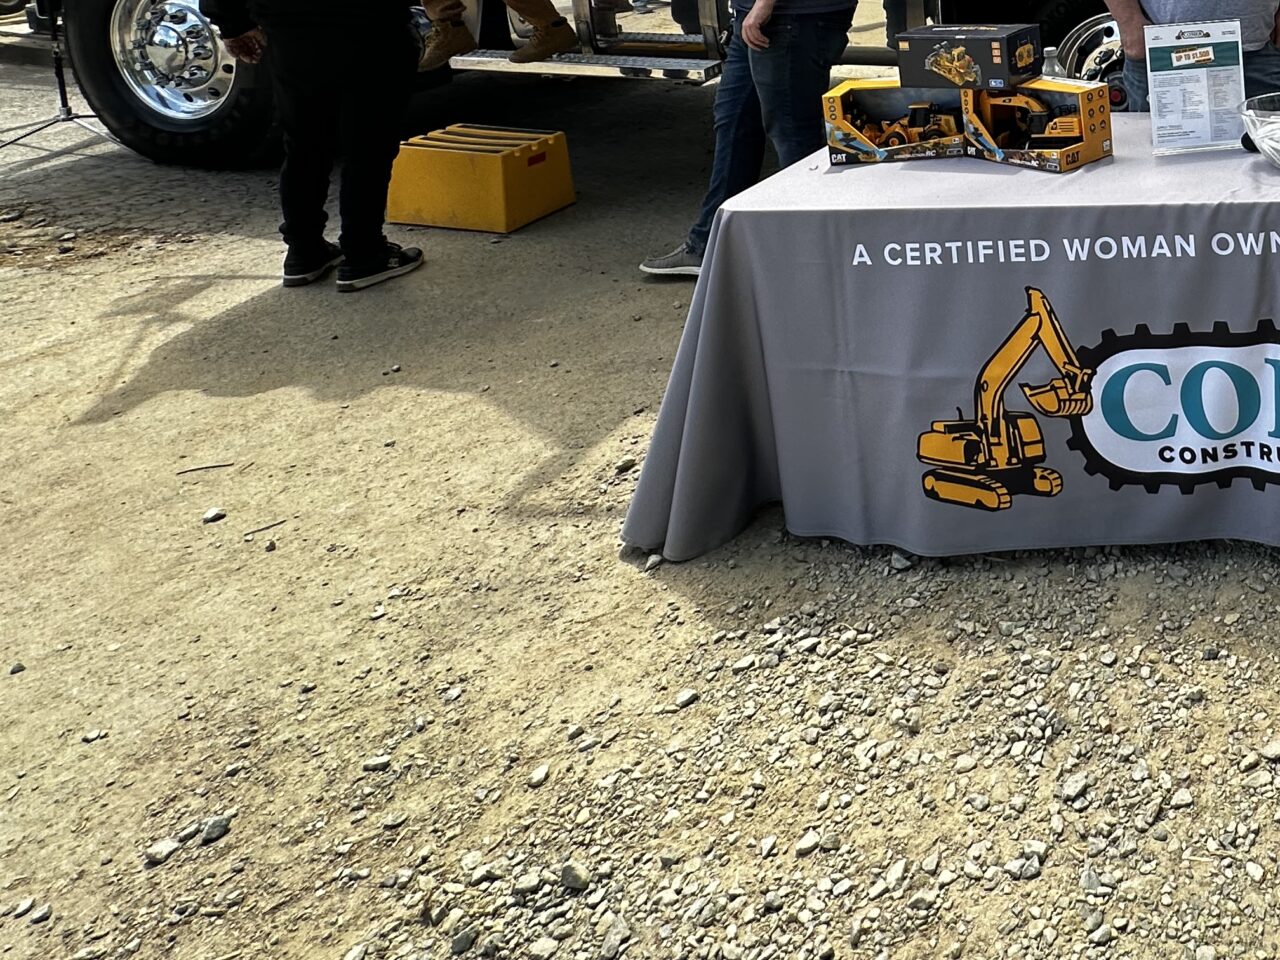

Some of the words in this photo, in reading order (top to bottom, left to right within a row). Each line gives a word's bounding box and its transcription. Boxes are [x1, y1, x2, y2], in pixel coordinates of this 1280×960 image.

[831, 153, 847, 163] CAT
[1065, 151, 1080, 165] CAT
[852, 243, 873, 266] A
[884, 239, 1051, 265] CERTIFIED
[1063, 234, 1196, 261] WOMAN
